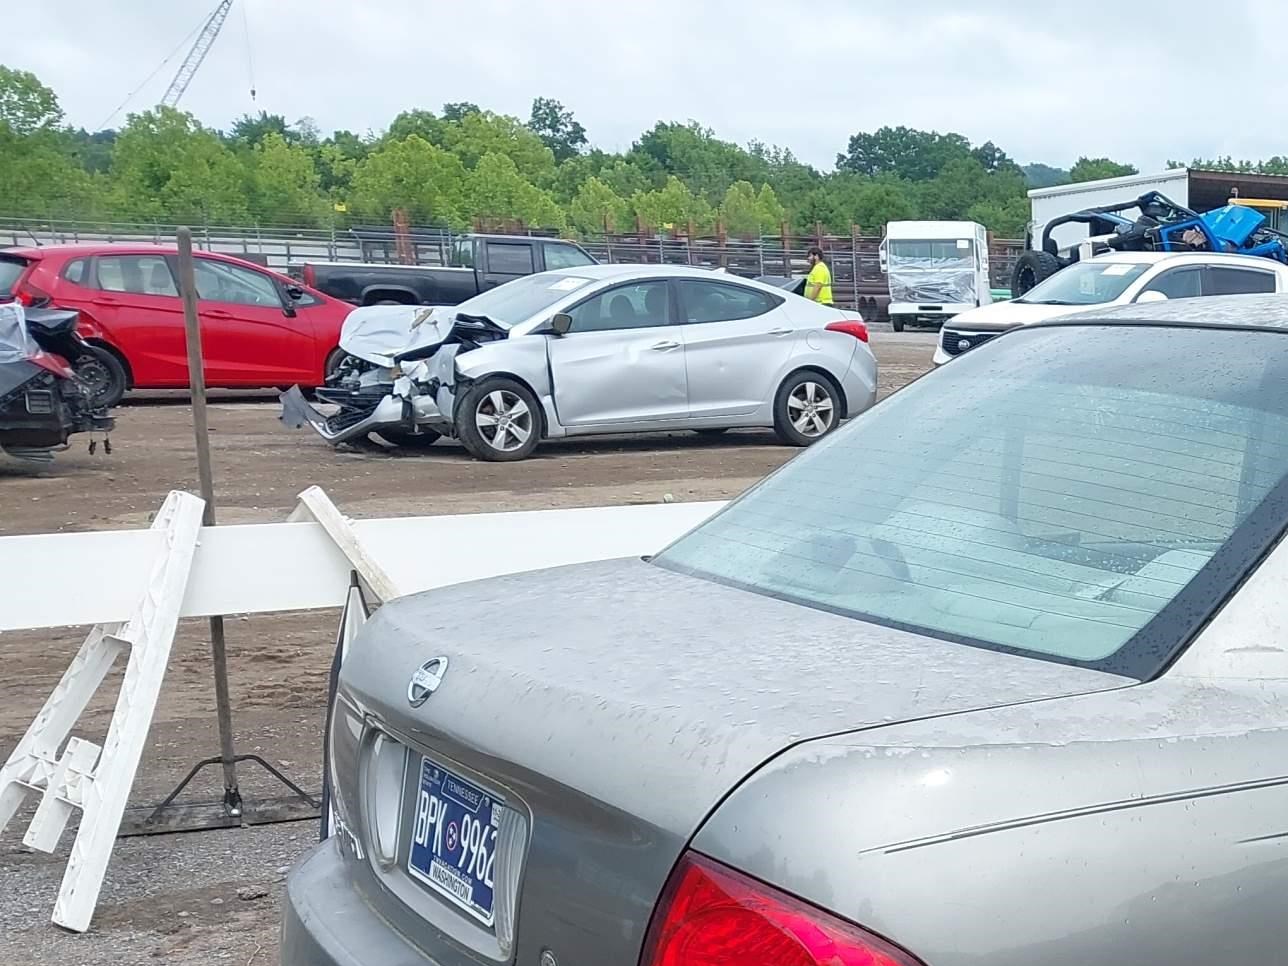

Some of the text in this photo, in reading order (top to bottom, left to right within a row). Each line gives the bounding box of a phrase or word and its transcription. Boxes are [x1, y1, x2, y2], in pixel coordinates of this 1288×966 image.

[447, 779, 479, 805] TENNESSEE
[415, 790, 448, 857] BPK
[431, 865, 471, 901] WASHINGTON
